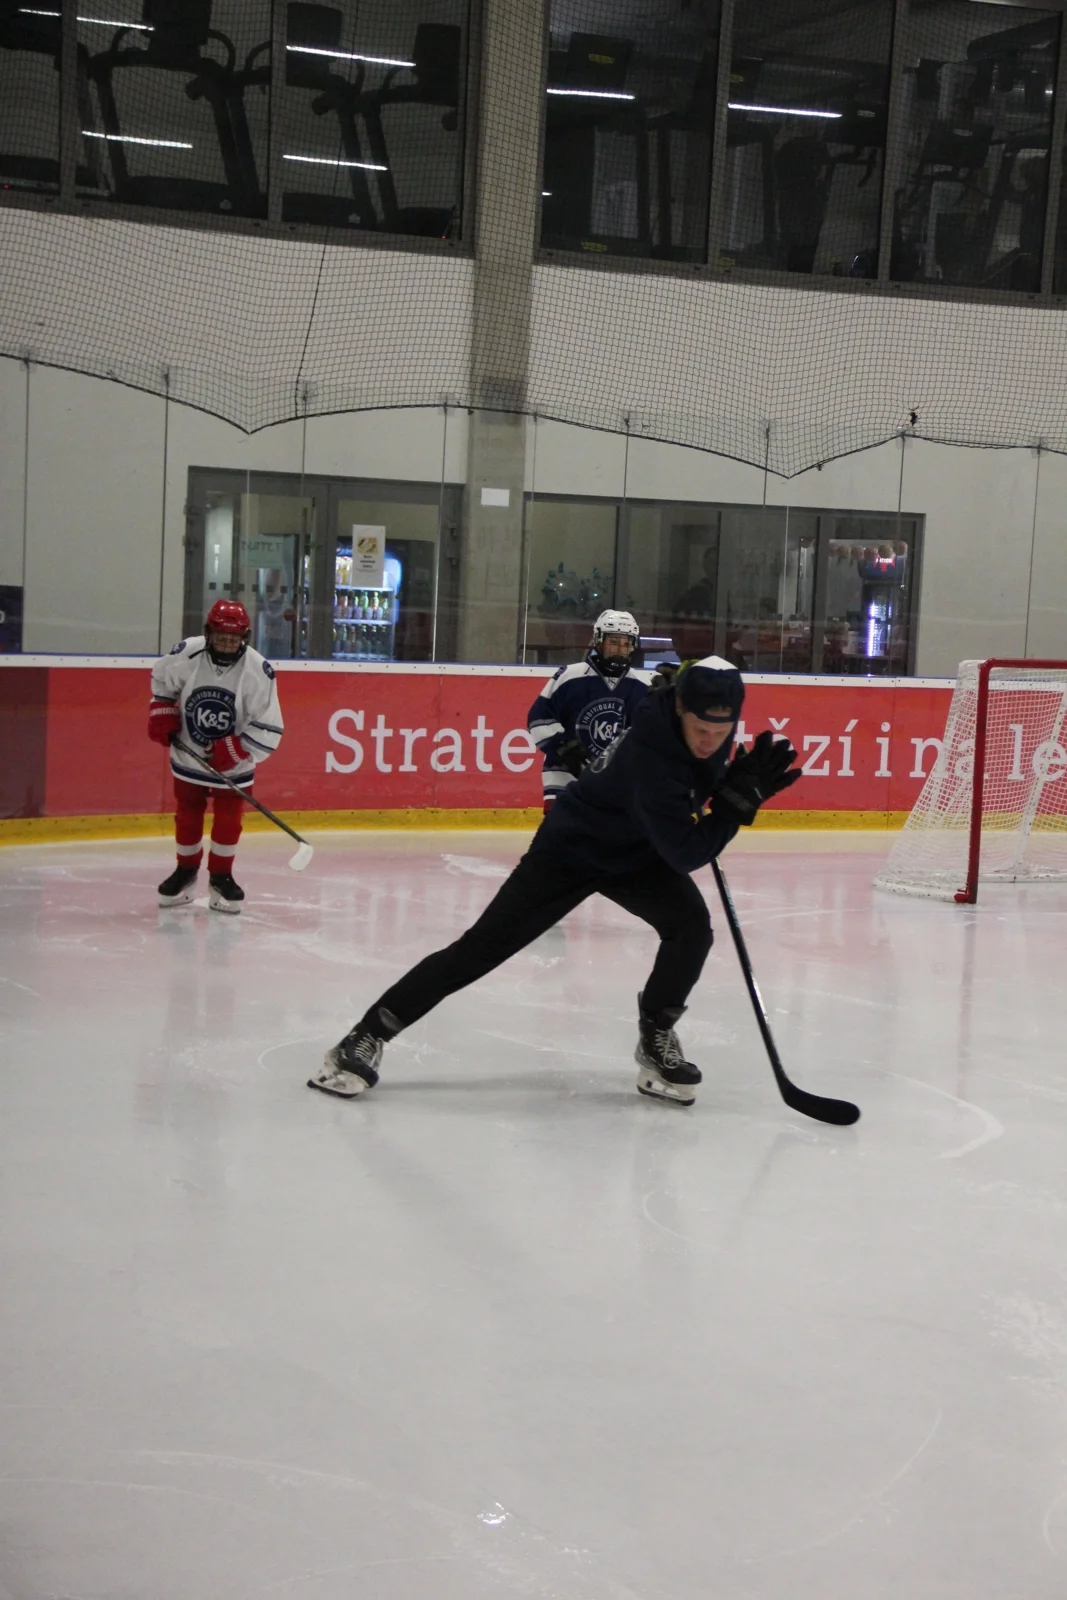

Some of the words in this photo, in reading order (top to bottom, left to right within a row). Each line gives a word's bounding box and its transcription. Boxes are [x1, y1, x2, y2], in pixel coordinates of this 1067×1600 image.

[197, 707, 231, 730] K&S
[582, 703, 616, 724] INDIVIDUAL
[325, 708, 546, 774] Strate
[874, 722, 892, 777] i
